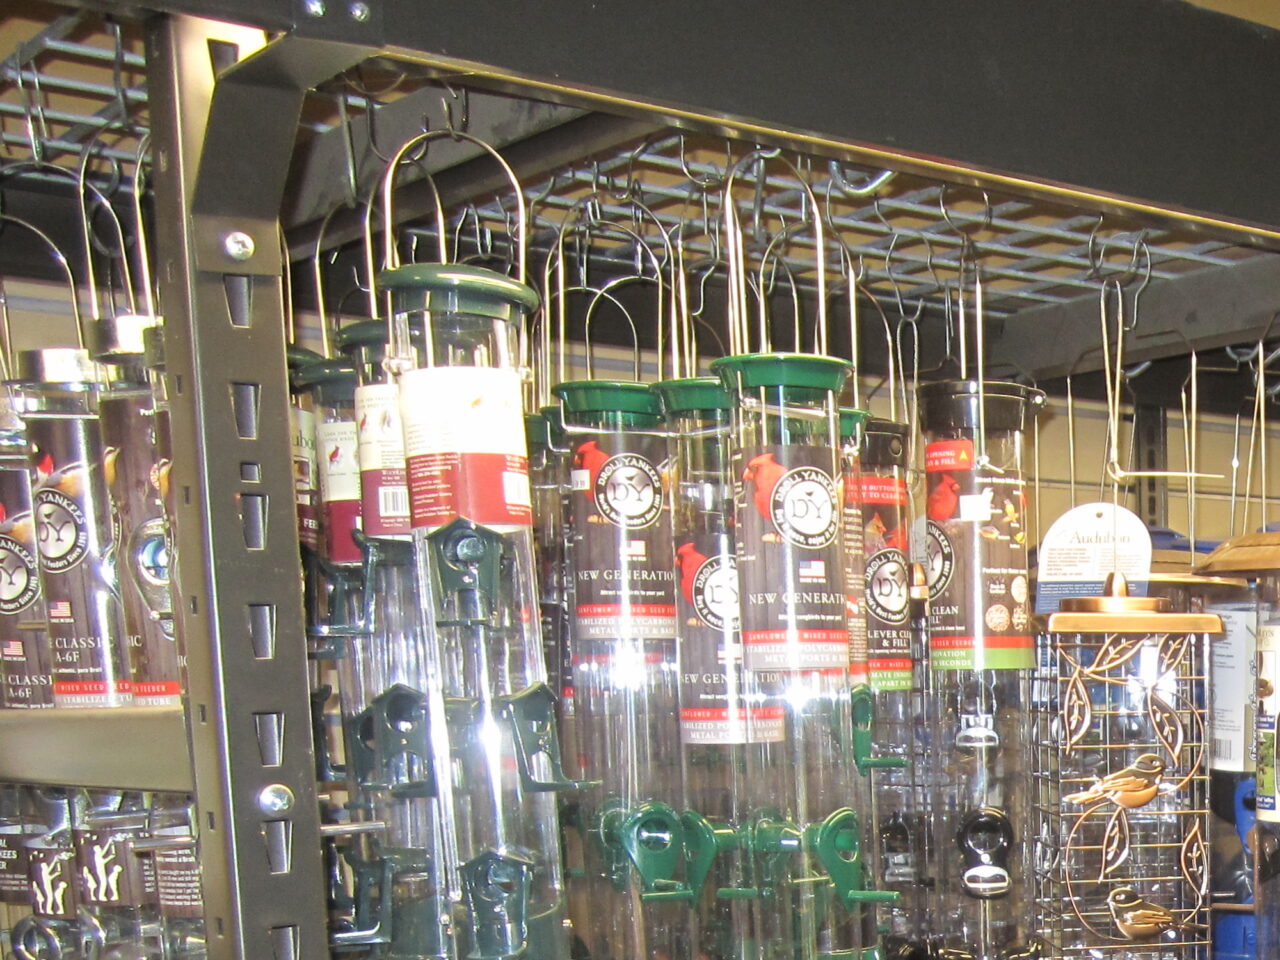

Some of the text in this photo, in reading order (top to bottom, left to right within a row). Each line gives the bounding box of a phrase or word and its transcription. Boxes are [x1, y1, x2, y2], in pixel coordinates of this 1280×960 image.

[942, 458, 956, 466] FILL
[578, 570, 674, 581] NEW GENERATIO
[749, 592, 846, 605] NEW GENERATI
[932, 605, 959, 615] CLEAN
[56, 651, 80, 662] A-6F
[8, 675, 53, 686] CLASSI
